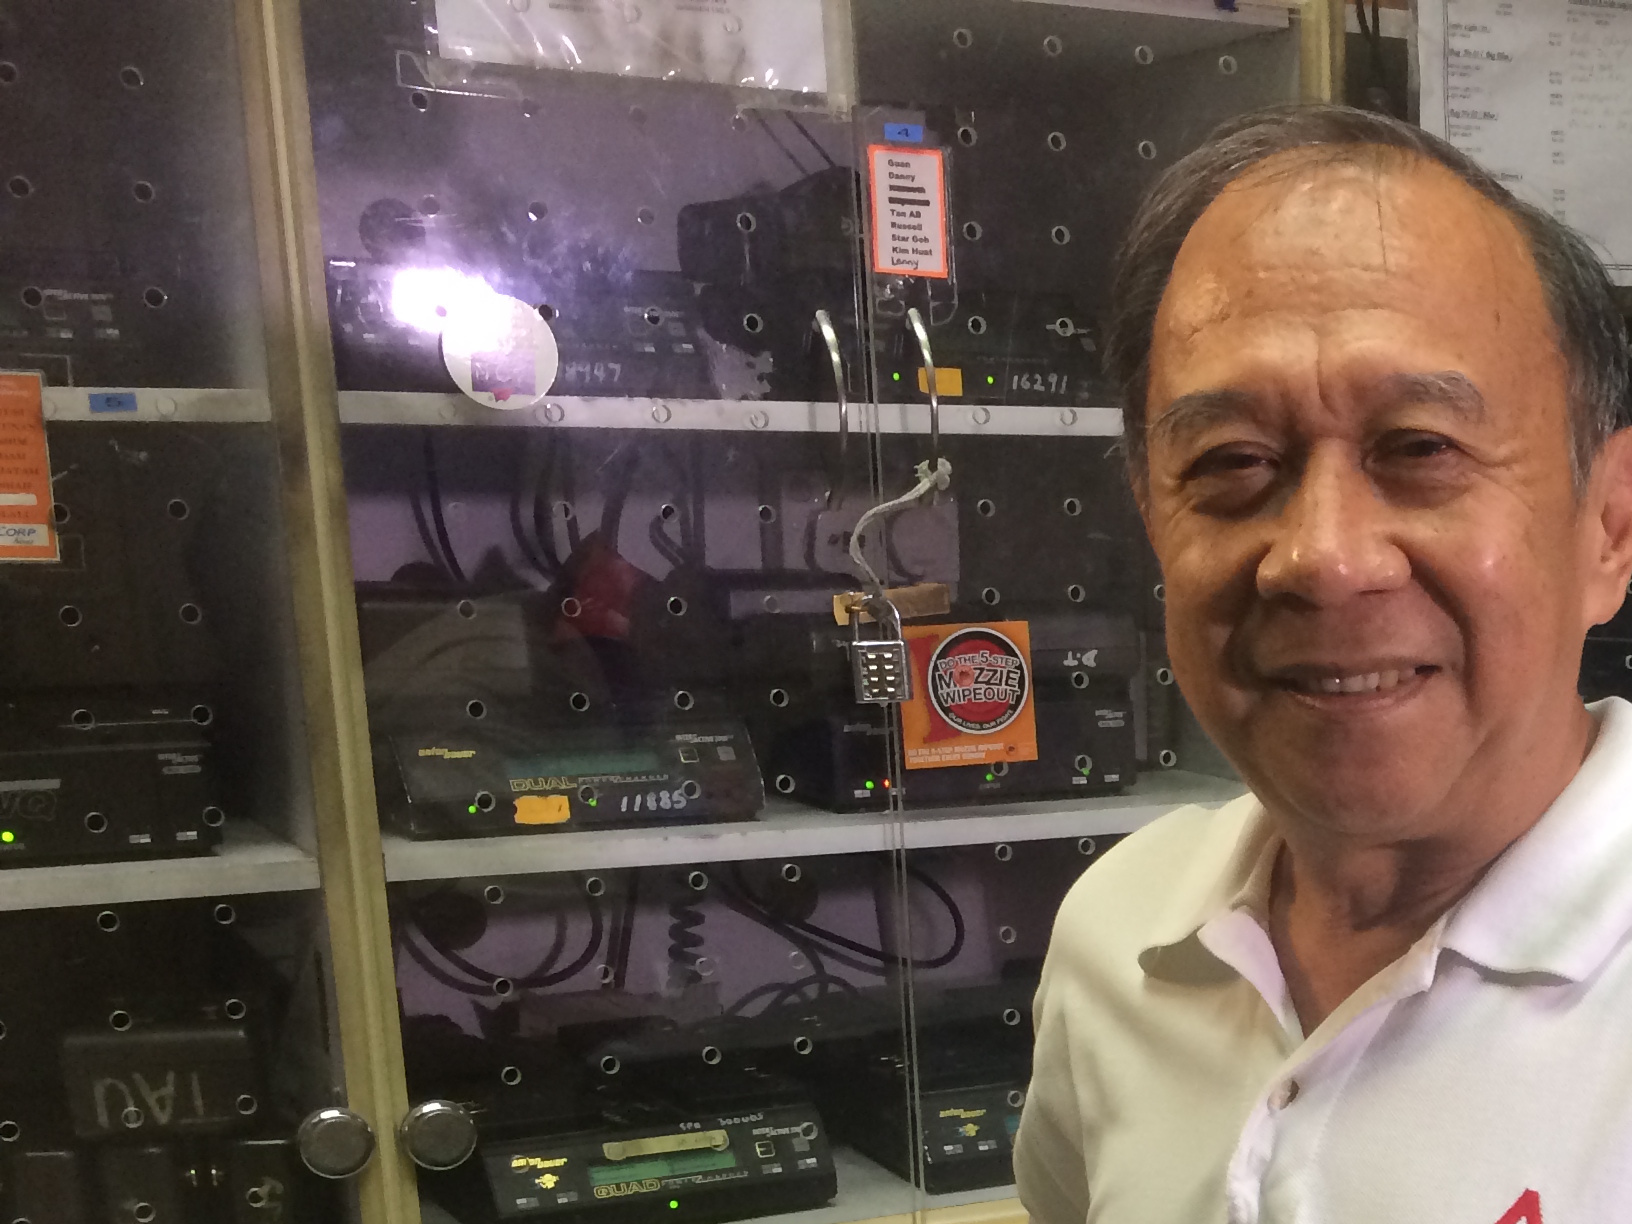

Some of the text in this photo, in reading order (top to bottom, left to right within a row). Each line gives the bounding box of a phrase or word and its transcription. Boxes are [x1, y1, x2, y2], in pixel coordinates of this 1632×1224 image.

[888, 158, 911, 169] Guan
[888, 172, 916, 183] Danny
[890, 221, 923, 231] Russell
[891, 233, 930, 244] Star Goh
[1012, 372, 1069, 395] 16291
[938, 651, 1020, 671] DO THE 5-STEP
[937, 687, 1021, 707] WIPEOUT
[509, 776, 578, 791] DUAL
[620, 789, 689, 812] 11885
[593, 1178, 661, 1199] QUAD
